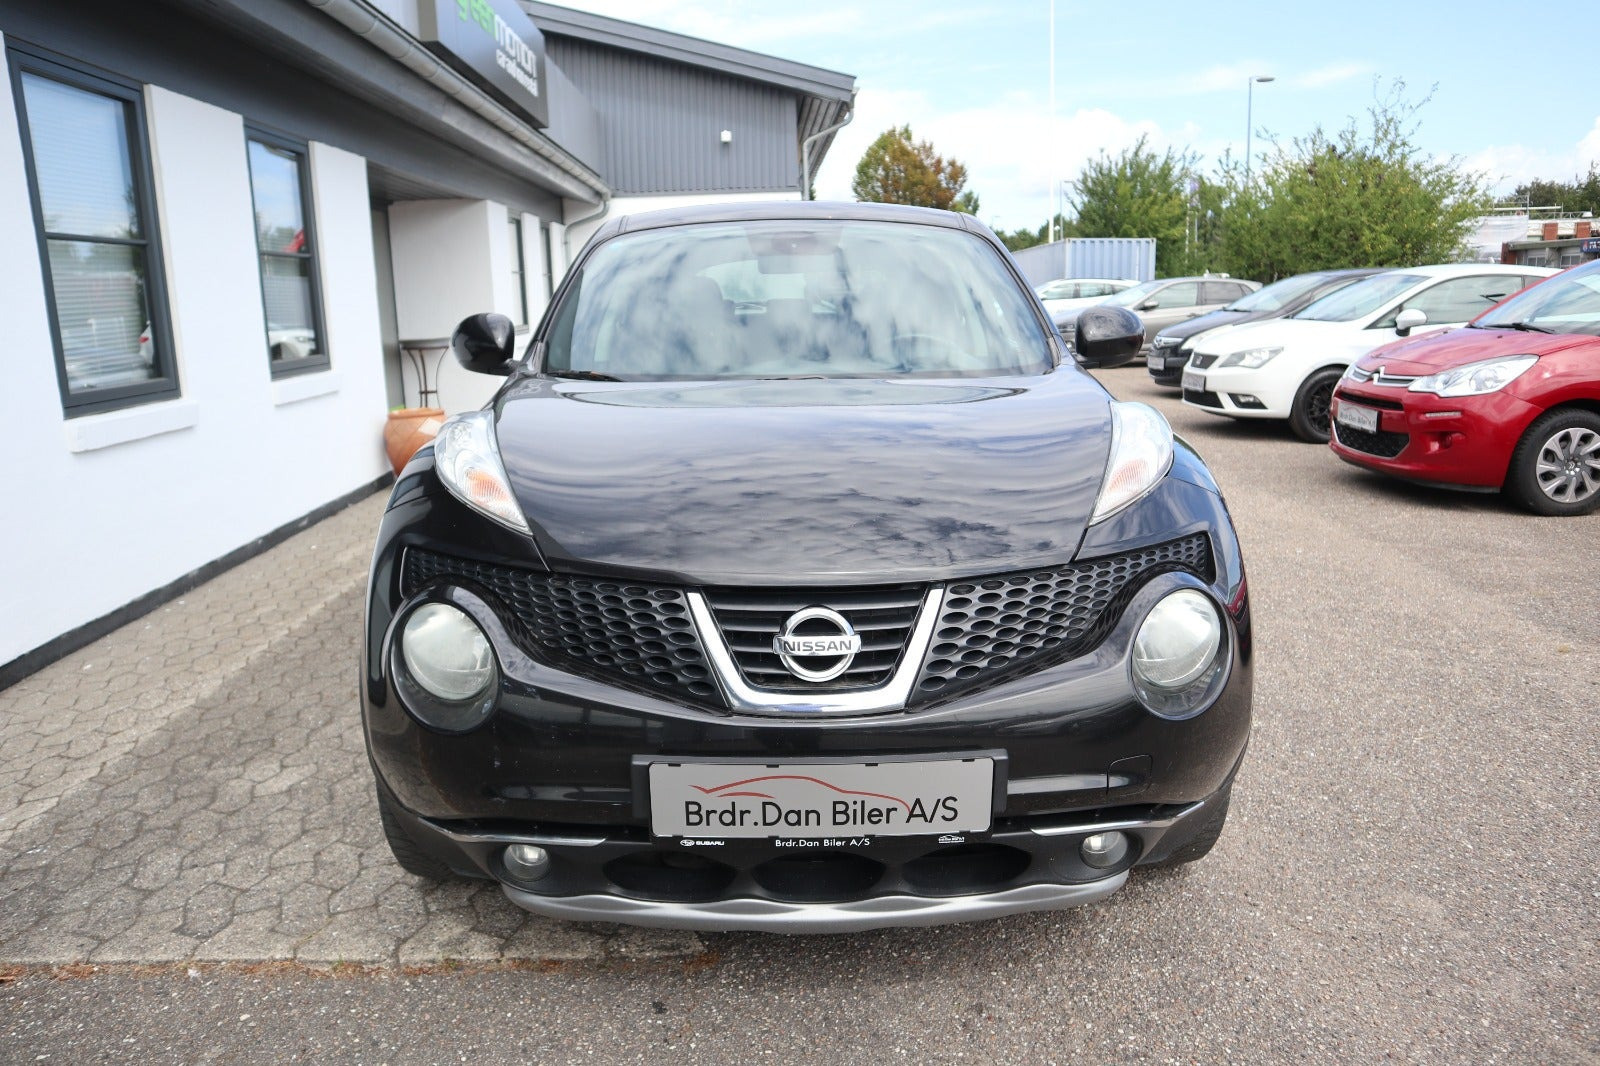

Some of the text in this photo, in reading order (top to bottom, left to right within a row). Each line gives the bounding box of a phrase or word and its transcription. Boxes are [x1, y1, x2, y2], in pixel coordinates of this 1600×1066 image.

[783, 640, 852, 651] NISSAN
[684, 796, 959, 827] Brdr.Dan Biler A/S
[775, 838, 870, 847] Brdr.Dan Biler A/S
